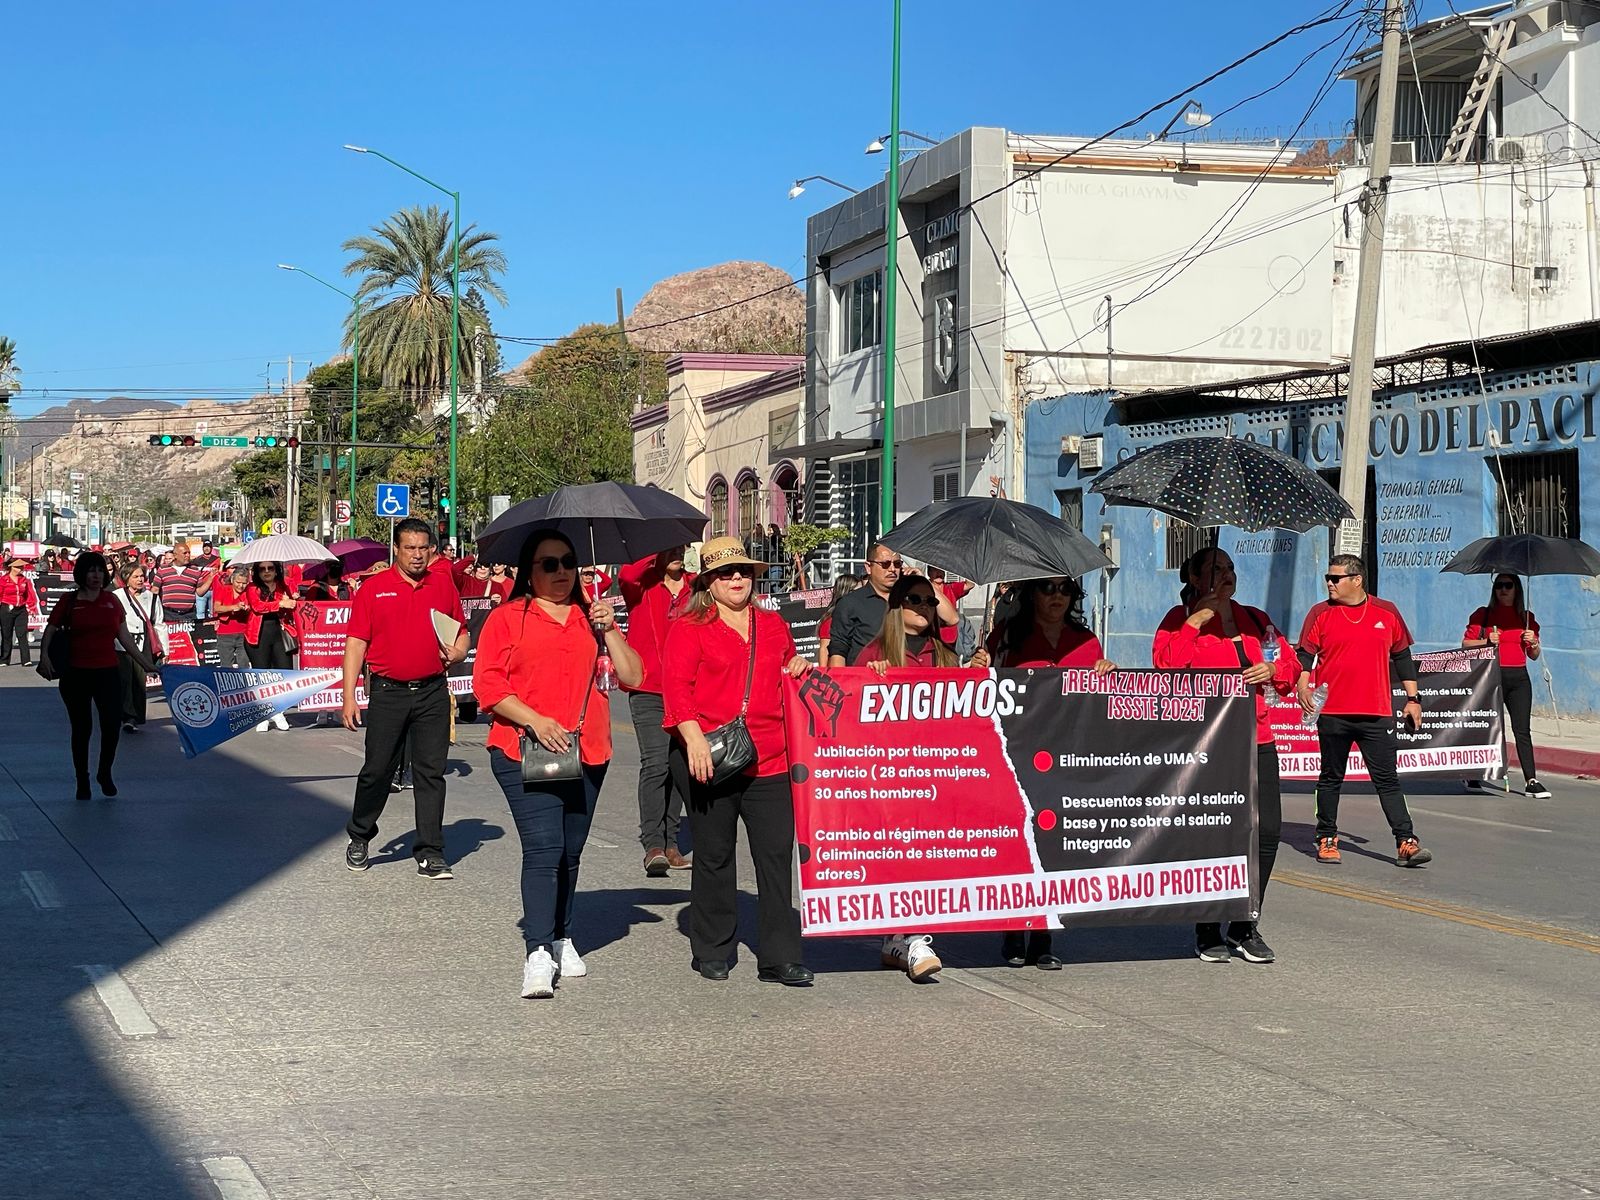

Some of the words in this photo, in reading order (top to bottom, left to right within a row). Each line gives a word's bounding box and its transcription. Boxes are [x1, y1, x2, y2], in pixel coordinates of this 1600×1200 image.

[1112, 185, 1188, 201] GUAYMAS
[926, 211, 961, 244] CLINIC
[1267, 412, 1410, 464] TECCO
[1418, 404, 1486, 454] DEL
[1499, 392, 1597, 444] PACI
[213, 438, 237, 446] DIEZ
[1380, 481, 1412, 499] TORNO
[1413, 480, 1426, 497] EN
[1427, 478, 1465, 496] GENERAL
[1381, 505, 1393, 521] SE
[1393, 503, 1432, 520] REPARAN
[1416, 527, 1428, 543] DE
[1428, 526, 1452, 543] AGUA
[1381, 550, 1423, 567] TRABAJOS
[1423, 551, 1433, 567] DE
[168, 622, 195, 634] GIMOS:
[213, 672, 246, 696] JARDIN
[245, 672, 258, 687] DE
[258, 670, 284, 685] NIÑOS
[219, 690, 257, 709] MARIA
[258, 682, 293, 699] ELENA
[296, 672, 337, 688] CHANES
[448, 680, 473, 692] PROTE
[1061, 669, 1171, 697] ¡RECHAZAMOS
[1172, 673, 1193, 697] LA
[1194, 673, 1221, 697] LEY
[1222, 673, 1249, 697] DEL
[313, 692, 332, 705] ESTA
[1439, 688, 1449, 696] de
[859, 679, 1027, 723] EXIGIMOS:
[1107, 696, 1158, 720] ISSSTE
[1160, 698, 1206, 721] 2025!
[1440, 709, 1461, 717] sobre
[1462, 709, 1470, 717] el
[1471, 709, 1498, 717] salario
[229, 717, 254, 733] GUAYMAS
[1270, 723, 1294, 731] ambio
[1294, 723, 1302, 731] al
[1431, 721, 1454, 729] sobre
[1463, 720, 1489, 728] salario
[1396, 732, 1433, 742] integrado
[814, 745, 885, 758] Jubilación
[888, 747, 910, 762] por
[912, 745, 959, 761] tiempo
[961, 745, 978, 757] de
[1275, 743, 1292, 752] res)
[1059, 752, 1142, 767] Eliminación
[1143, 752, 1162, 766] de
[1279, 757, 1300, 772] STA
[1419, 751, 1448, 767] BAJO
[814, 766, 868, 779] servicio
[879, 766, 896, 778] 28
[898, 765, 931, 778] años
[933, 765, 991, 781] mujeres,
[815, 787, 832, 800] 30
[834, 786, 868, 800] años
[869, 785, 938, 801] hombres)
[1062, 795, 1142, 809] Descuentos
[1144, 793, 1186, 808] sobre
[1188, 793, 1200, 806] el
[1202, 791, 1246, 806] salario
[1063, 816, 1097, 830] base
[1099, 818, 1109, 833] y
[1110, 817, 1128, 829] no
[1130, 814, 1171, 829] sobre
[1173, 813, 1186, 827] el
[1188, 812, 1232, 826] salario
[815, 828, 871, 841] Cambio
[873, 827, 887, 840] al
[888, 828, 945, 843] régimen
[947, 826, 964, 839] de
[966, 826, 1019, 843] pensión
[1062, 837, 1132, 854] integrado
[816, 847, 903, 863] (eliminación
[905, 847, 923, 859] de
[925, 847, 979, 859] sistema
[981, 846, 997, 858] de
[815, 866, 867, 883] afores)
[801, 896, 832, 929] ¡EN
[838, 893, 885, 922] ESTA
[890, 887, 971, 918] ESCUELA
[975, 875, 1104, 914] TRABAJAMOS
[1107, 871, 1155, 901] BAJO
[1160, 863, 1247, 897] PROTESTA!
